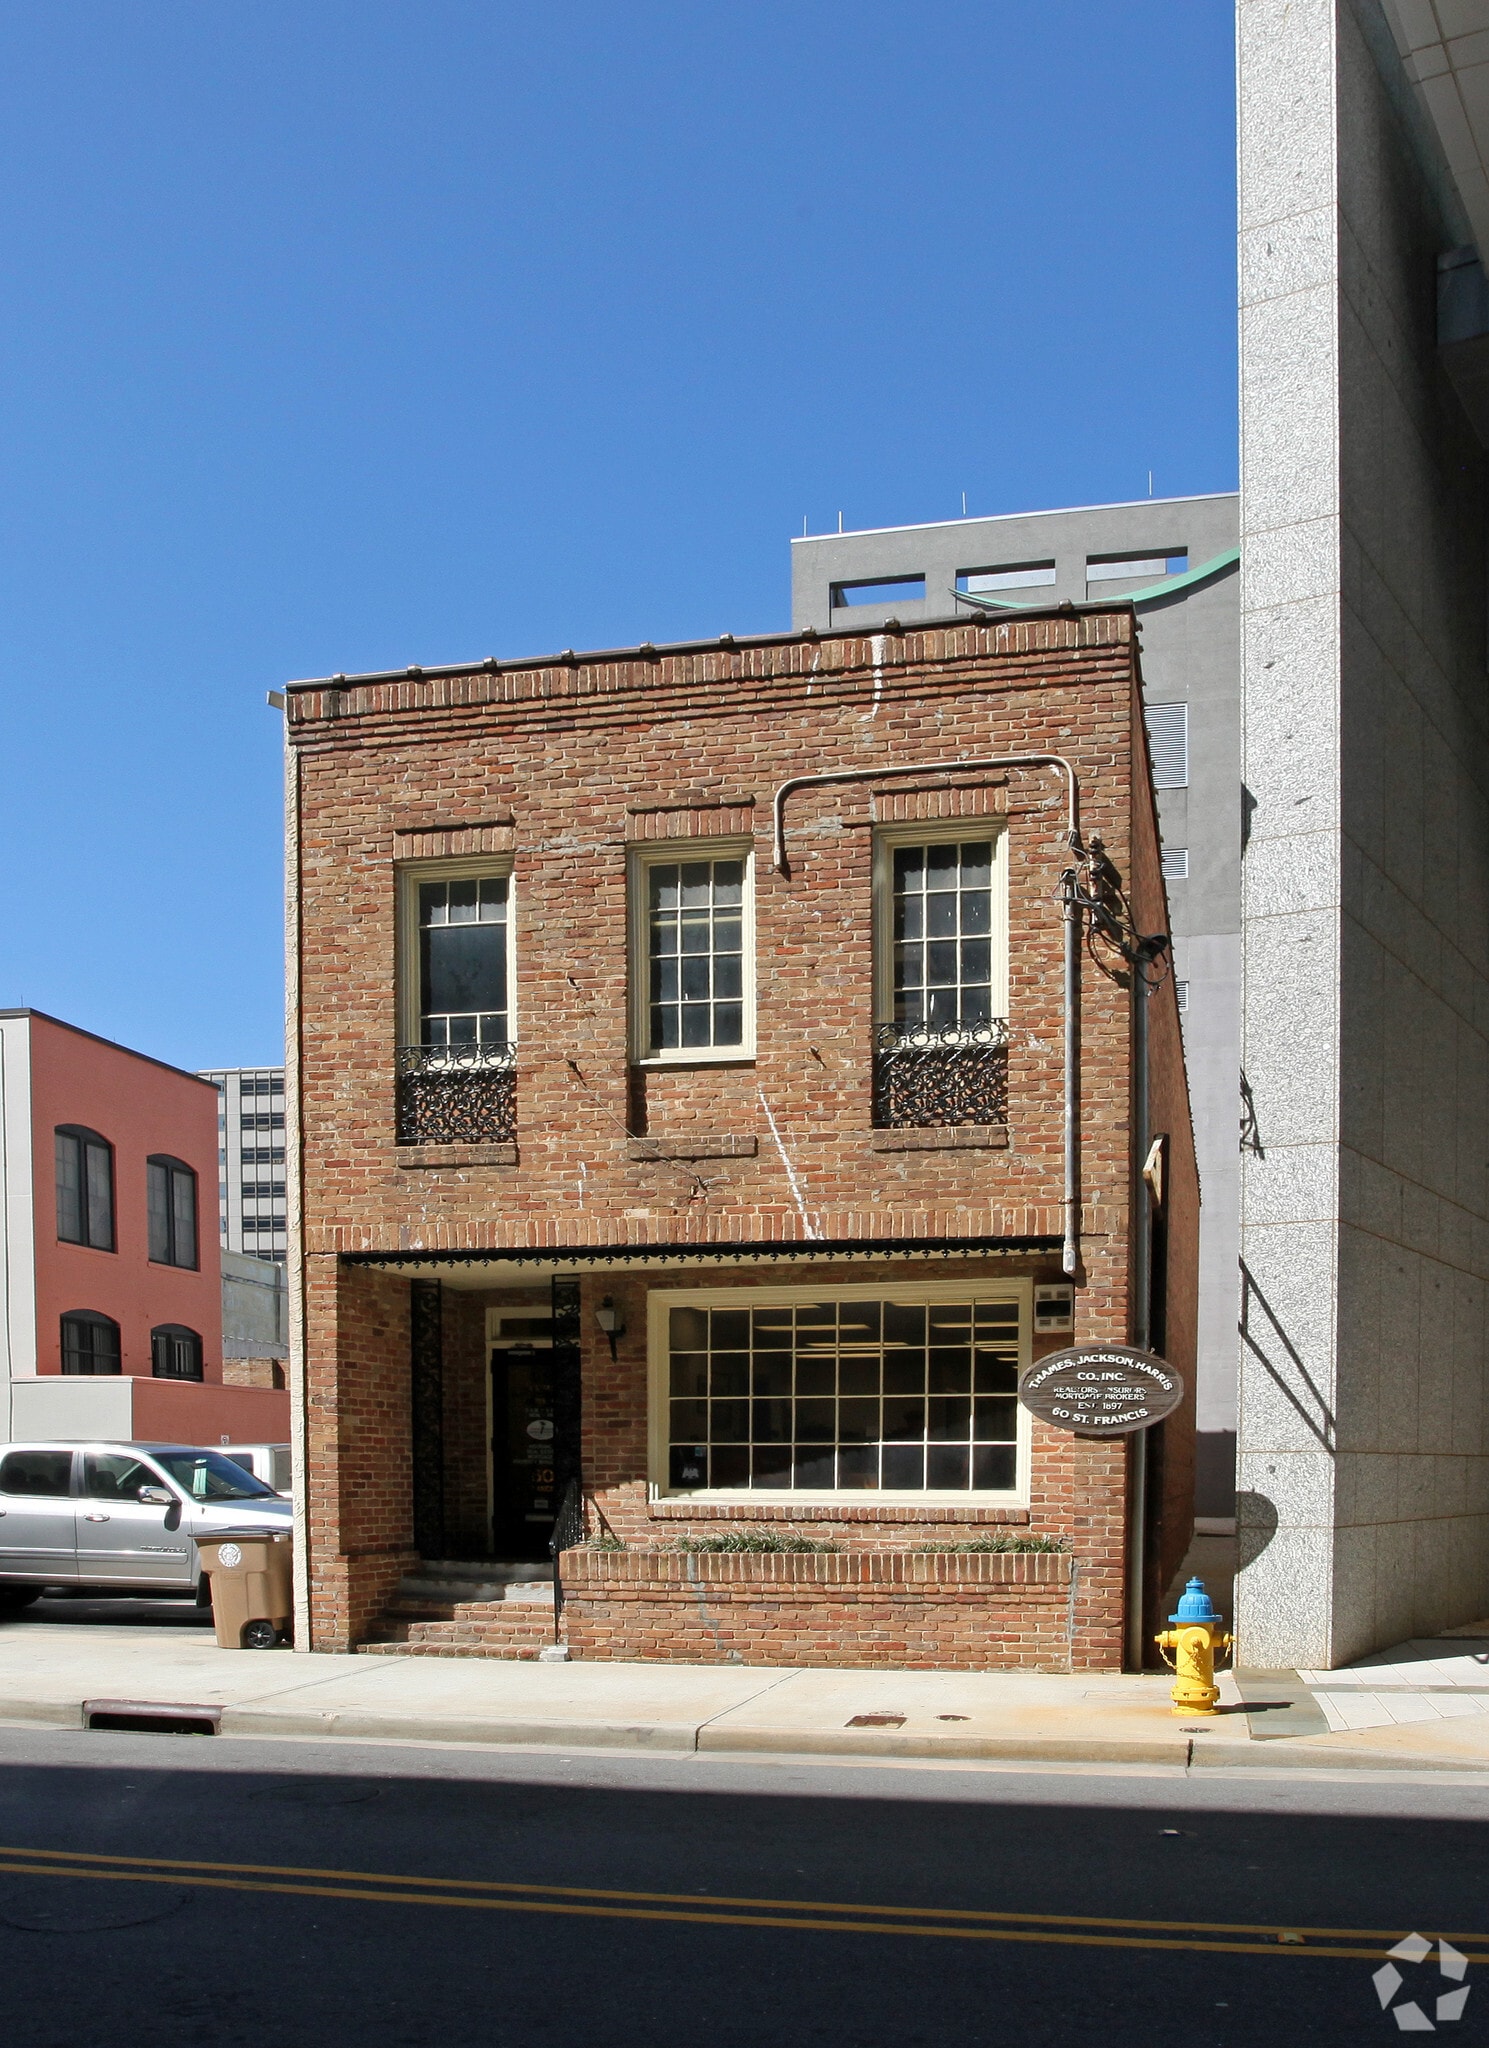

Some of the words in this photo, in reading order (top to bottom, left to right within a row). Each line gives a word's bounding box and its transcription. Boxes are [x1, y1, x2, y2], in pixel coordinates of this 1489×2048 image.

[1028, 1358, 1076, 1390] THAMES,
[1077, 1354, 1134, 1368] JACKSON,
[1135, 1361, 1173, 1391] HARRIS
[1101, 1372, 1126, 1381] INC.
[1053, 1386, 1099, 1394] REALORS
[1105, 1386, 1147, 1394] NSURRS
[1104, 1393, 1145, 1401] BROKERS
[1102, 1402, 1123, 1410] 1897
[1052, 1407, 1070, 1419] 60
[1072, 1413, 1090, 1424] ST.
[1094, 1408, 1149, 1425] FRANCIS
